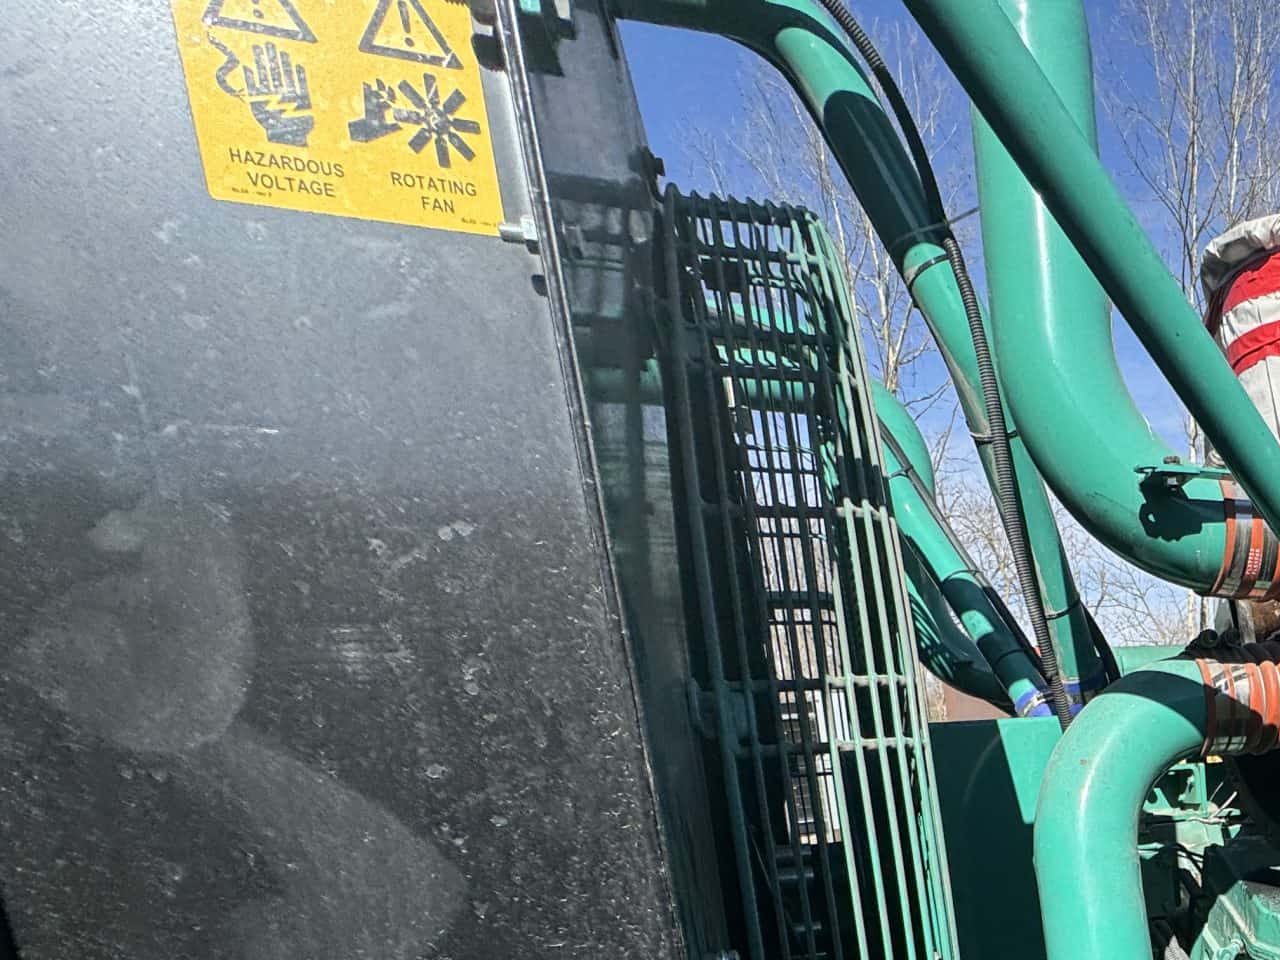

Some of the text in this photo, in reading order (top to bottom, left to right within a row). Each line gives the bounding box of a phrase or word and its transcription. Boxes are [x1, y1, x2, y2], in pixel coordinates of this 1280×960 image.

[228, 147, 345, 178] HAZARDOUS
[246, 171, 336, 198] VOLTAGE
[390, 171, 477, 197] ROTATING
[421, 196, 455, 214] FAN
